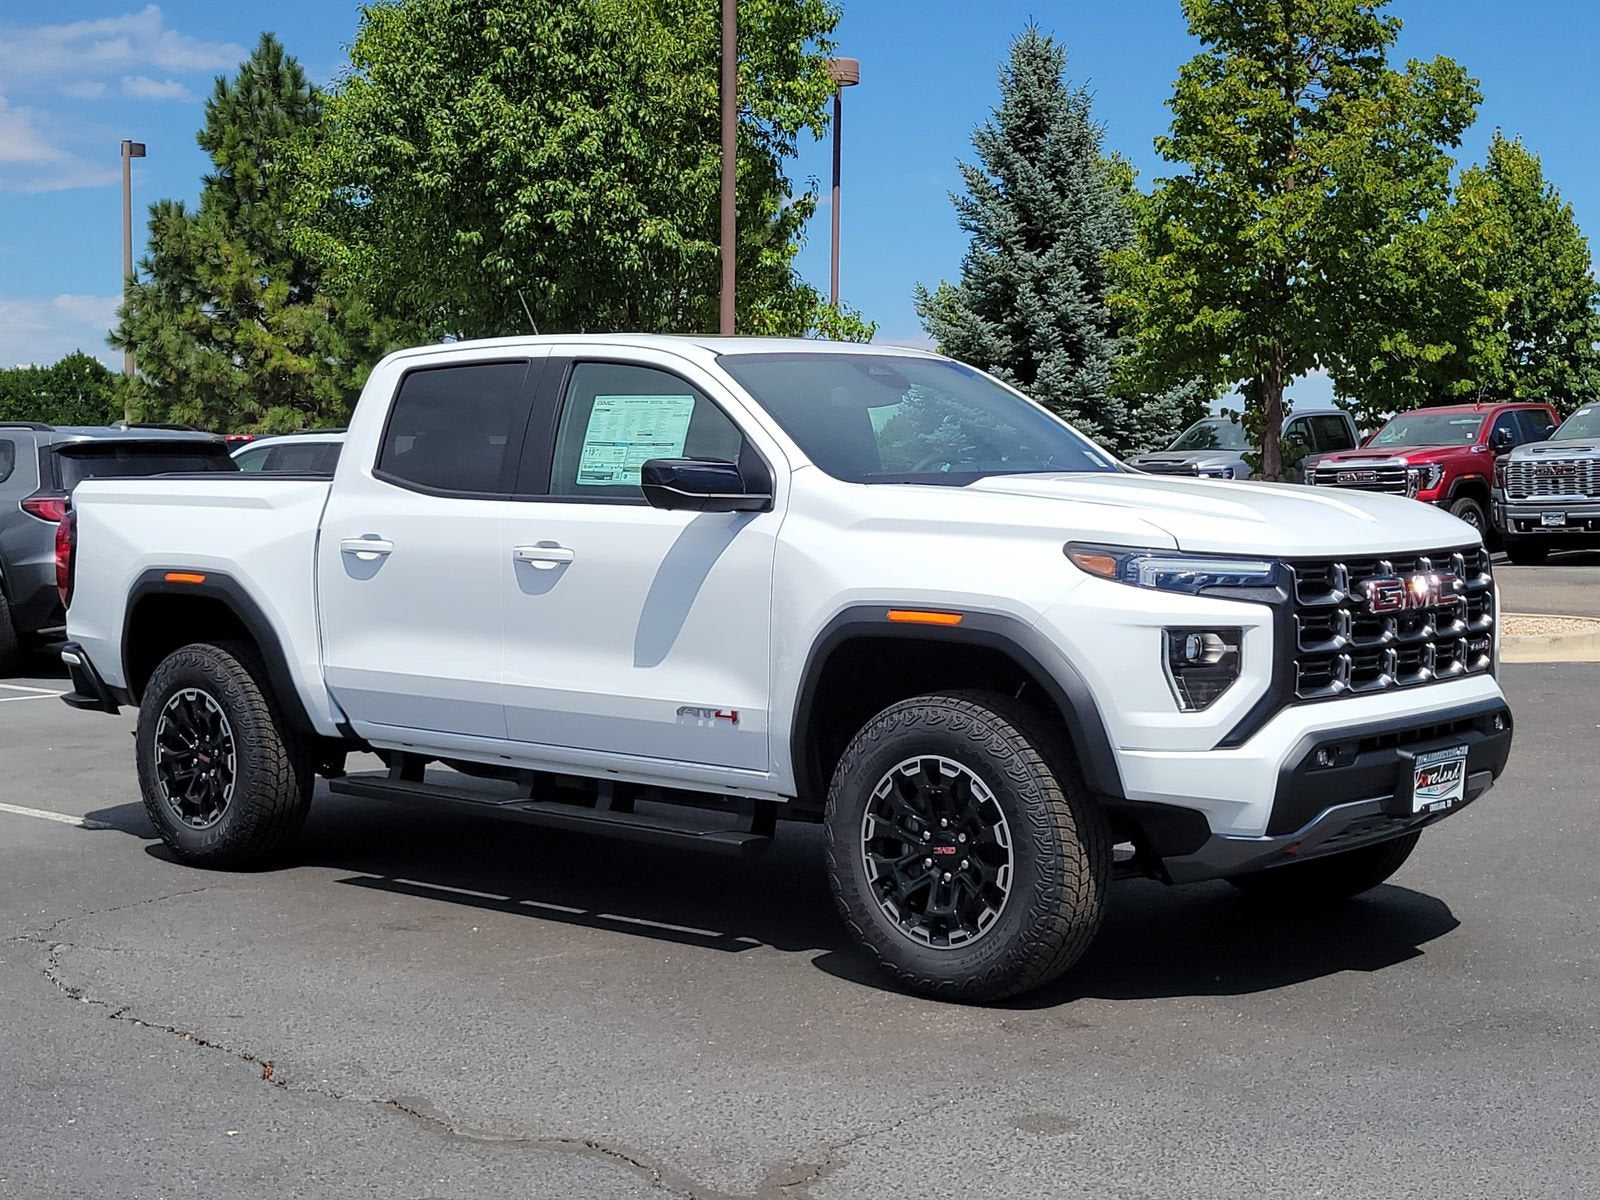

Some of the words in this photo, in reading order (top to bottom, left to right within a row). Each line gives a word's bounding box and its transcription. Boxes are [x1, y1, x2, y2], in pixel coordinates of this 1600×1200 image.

[1369, 574, 1459, 614] GMC
[676, 706, 739, 725] AT4
[933, 846, 956, 855] GMC
